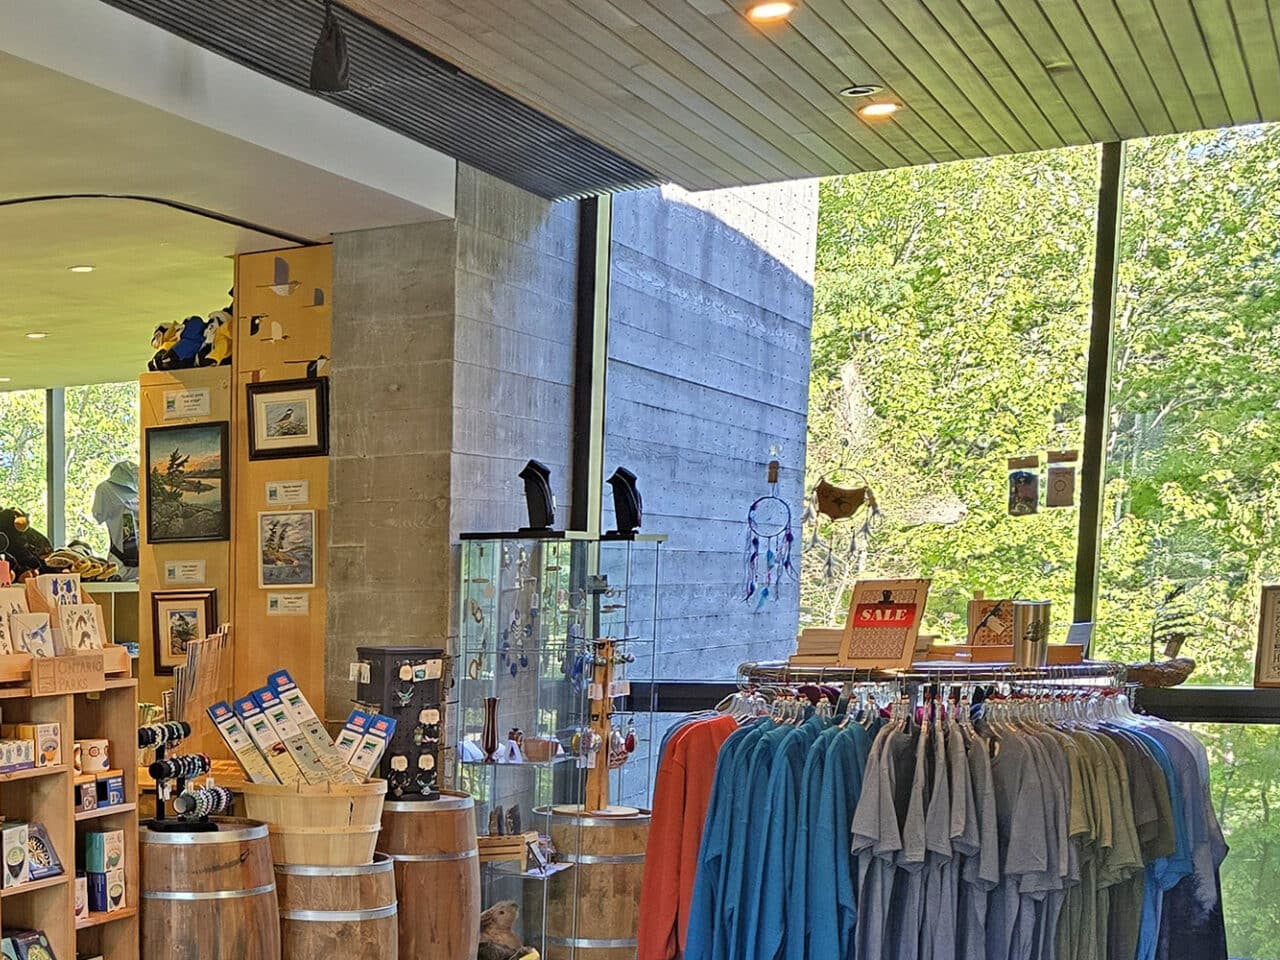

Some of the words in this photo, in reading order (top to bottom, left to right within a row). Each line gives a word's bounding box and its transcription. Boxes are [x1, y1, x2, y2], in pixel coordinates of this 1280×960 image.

[860, 609, 907, 621] SALE
[58, 660, 103, 673] ONTARIO
[58, 678, 88, 690] PARKS
